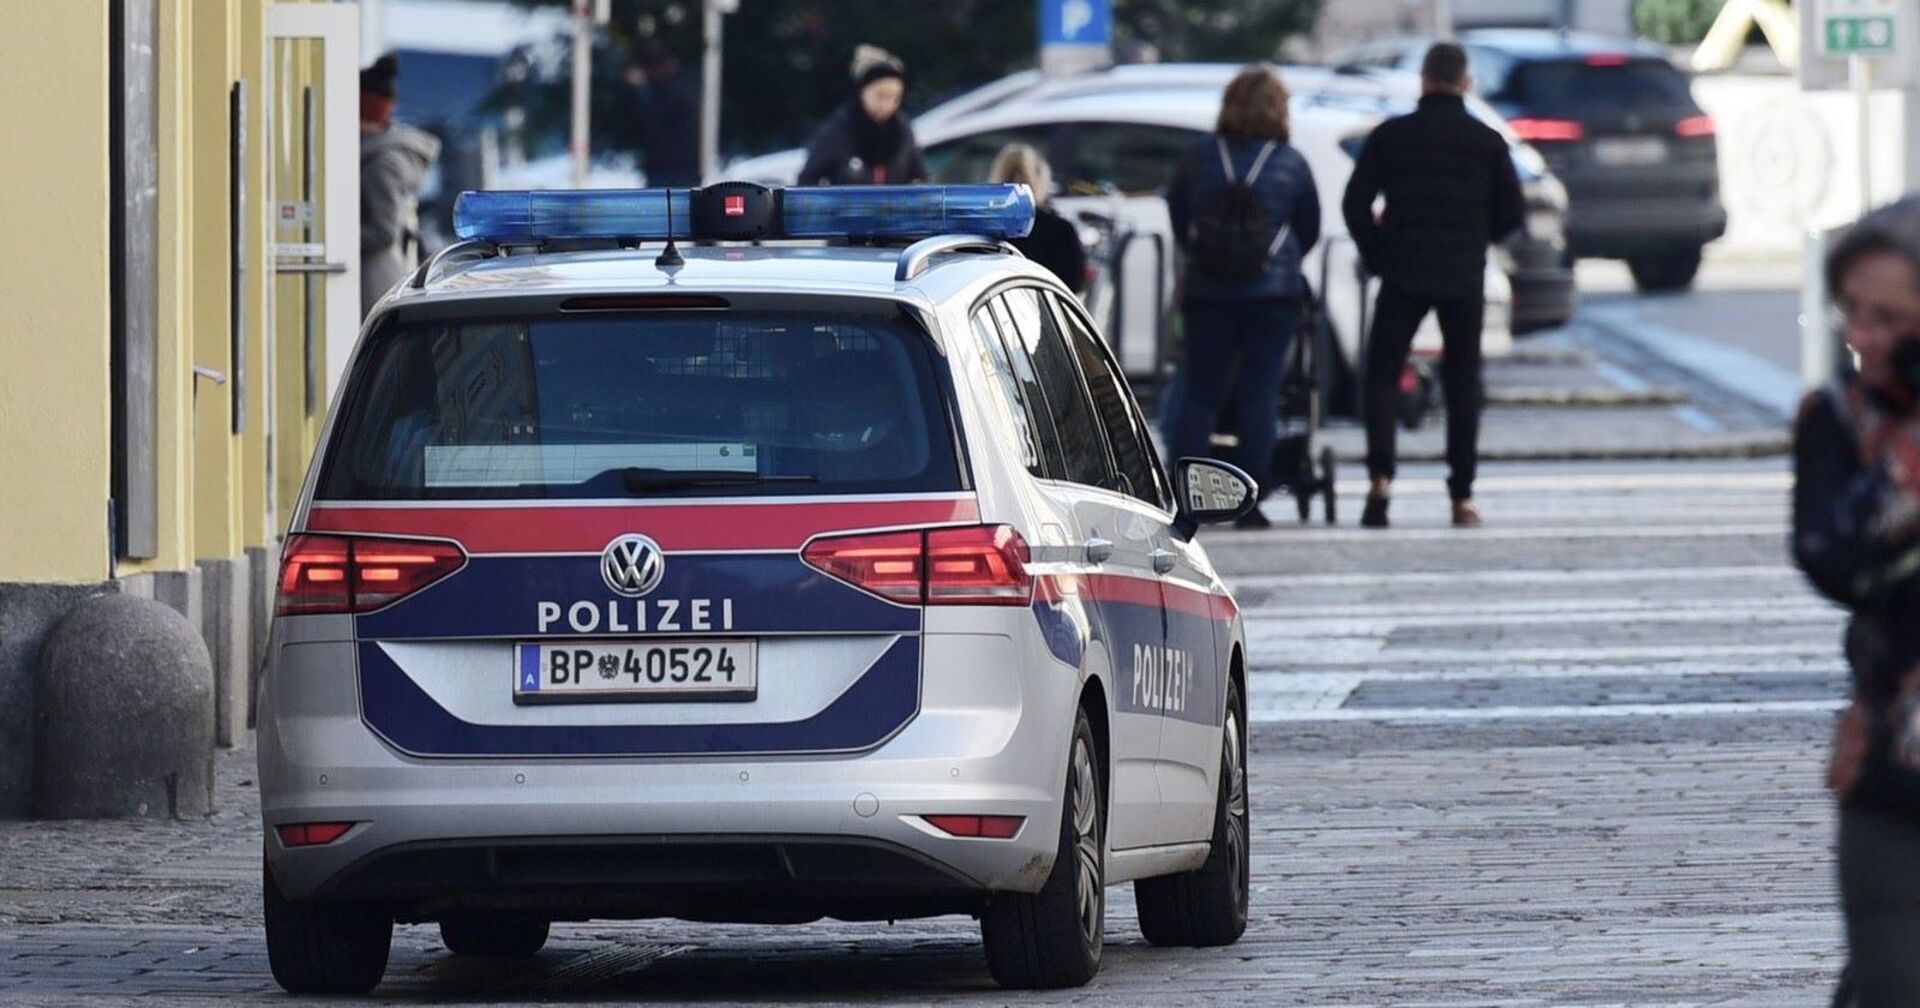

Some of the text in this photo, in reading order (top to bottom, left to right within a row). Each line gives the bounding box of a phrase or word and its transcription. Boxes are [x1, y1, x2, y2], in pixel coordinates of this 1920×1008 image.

[1061, 0, 1094, 40] P
[537, 598, 733, 633] POLIZEI
[524, 673, 536, 685] A
[550, 647, 736, 684] BP 40524
[1132, 643, 1186, 712] POLIZEI
